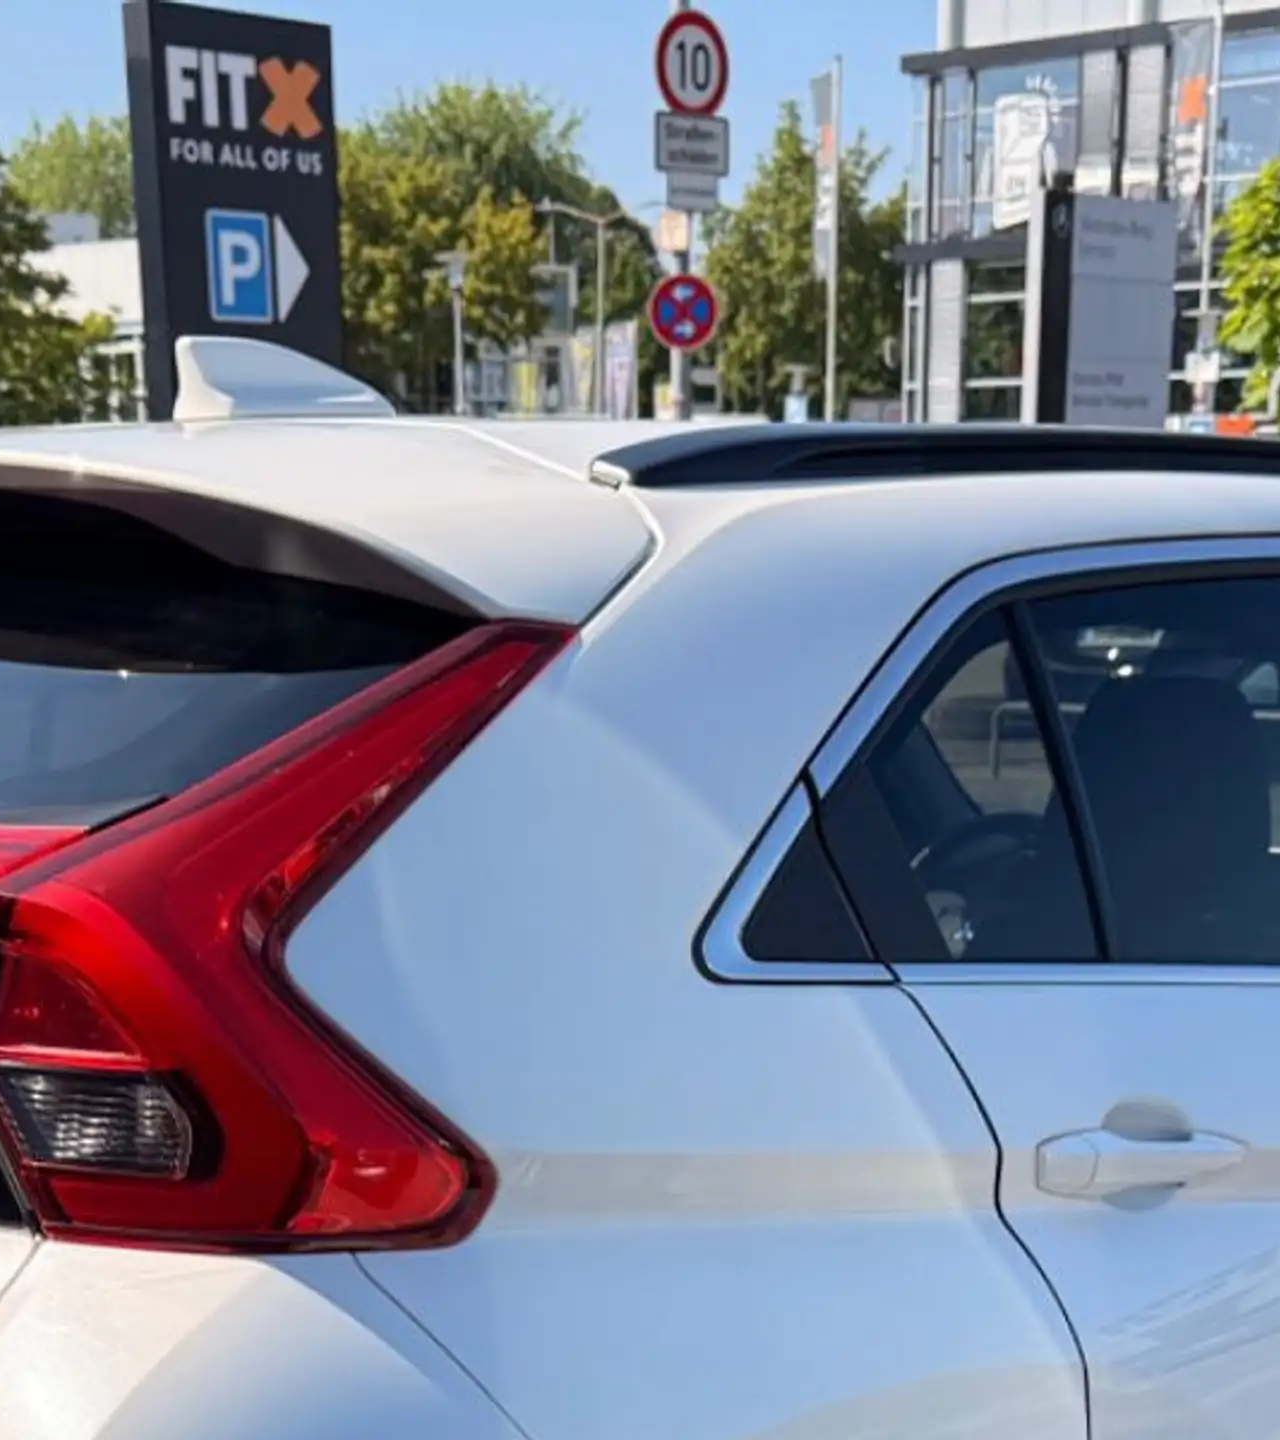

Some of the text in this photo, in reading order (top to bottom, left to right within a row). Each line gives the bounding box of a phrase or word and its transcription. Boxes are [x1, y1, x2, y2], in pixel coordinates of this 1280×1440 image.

[675, 40, 711, 93] 10
[170, 138, 324, 176] FOR ALL OF US
[218, 229, 261, 307] P
